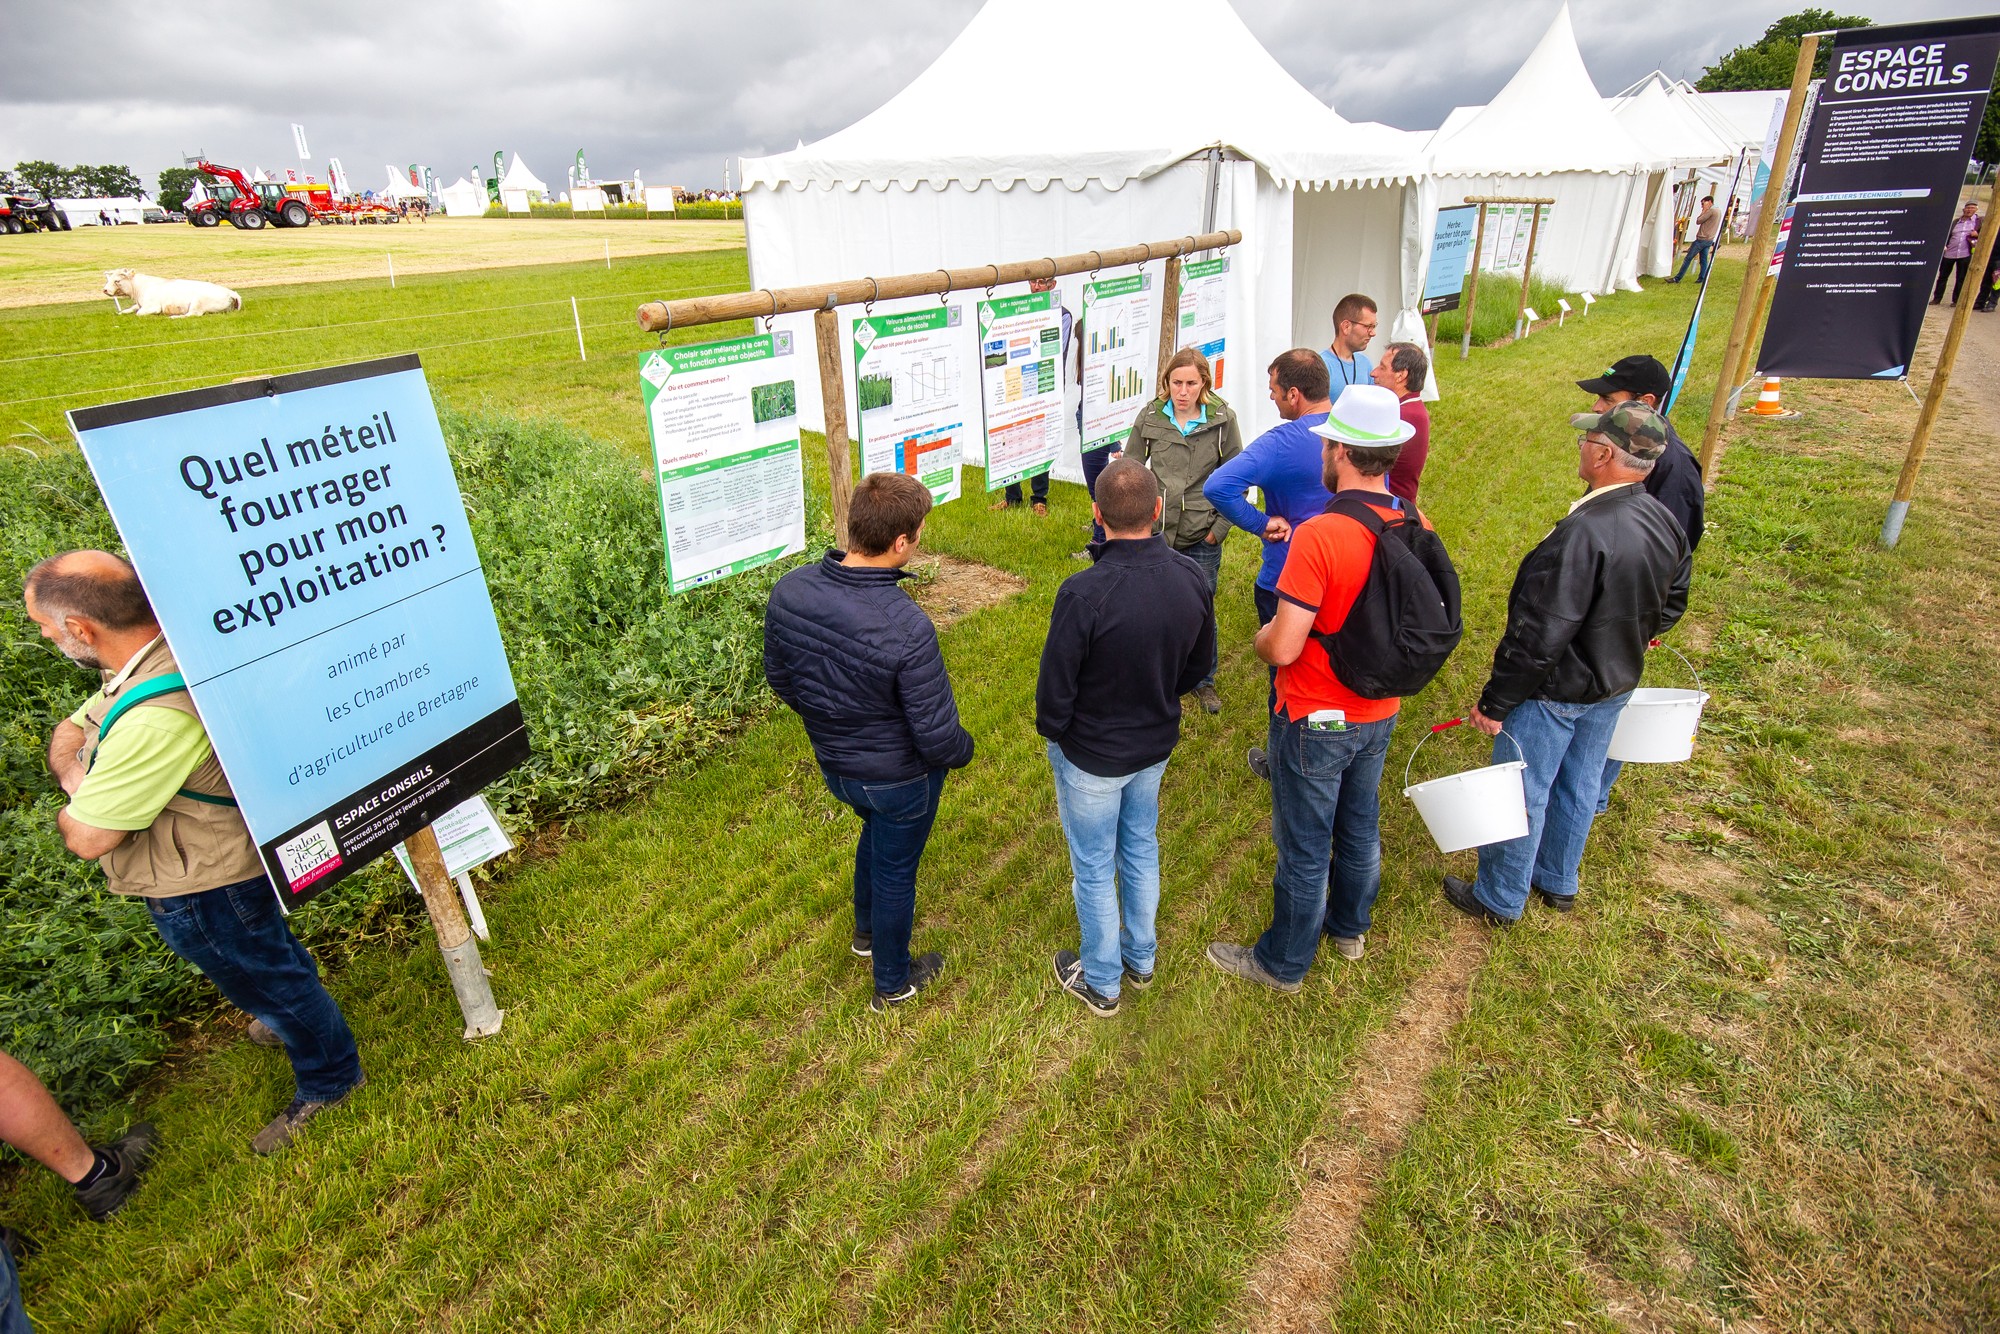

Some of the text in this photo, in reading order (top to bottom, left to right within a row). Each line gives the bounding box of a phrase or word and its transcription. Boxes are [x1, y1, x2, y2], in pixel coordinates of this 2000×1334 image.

[1839, 44, 1946, 72] ESPACE
[1834, 64, 1969, 93] CONSEILS
[1435, 231, 1452, 240] faucher
[1447, 220, 1460, 229] Herbe
[1437, 242, 1453, 251] gagner
[1453, 239, 1462, 248] plus
[886, 317, 902, 325] Valeurs
[904, 314, 930, 323] alimentaires
[674, 350, 698, 360] Choisir
[714, 345, 740, 354] mélange
[754, 340, 768, 348] carte
[690, 358, 716, 367] fonction
[740, 349, 765, 360] objectifs
[684, 379, 709, 388] comment
[180, 411, 396, 499] Quel méteil
[663, 456, 678, 464] Quels
[679, 451, 703, 460] mélanges
[219, 464, 391, 532] fourrager
[239, 504, 407, 586] pour mon
[212, 524, 446, 634] exploitation ?
[327, 633, 405, 678] animé par
[325, 662, 430, 722] les Chambres
[288, 676, 479, 785] d'agriculture de Bretagne
[335, 765, 433, 829] ESPACE CONSEILS
[343, 826, 372, 847] mercredi
[383, 813, 394, 824] mai
[402, 799, 418, 814] jeudi
[426, 788, 436, 797] mai
[437, 778, 450, 790] 2018
[438, 812, 478, 834] protéagineux
[286, 833, 320, 856] Salon
[351, 828, 386, 852] Nouvoitou
[386, 820, 400, 832] (35)
[291, 850, 333, 877] l'herbe
[295, 852, 309, 864] de
[300, 876, 310, 884] des
[310, 858, 339, 880] fourrages
